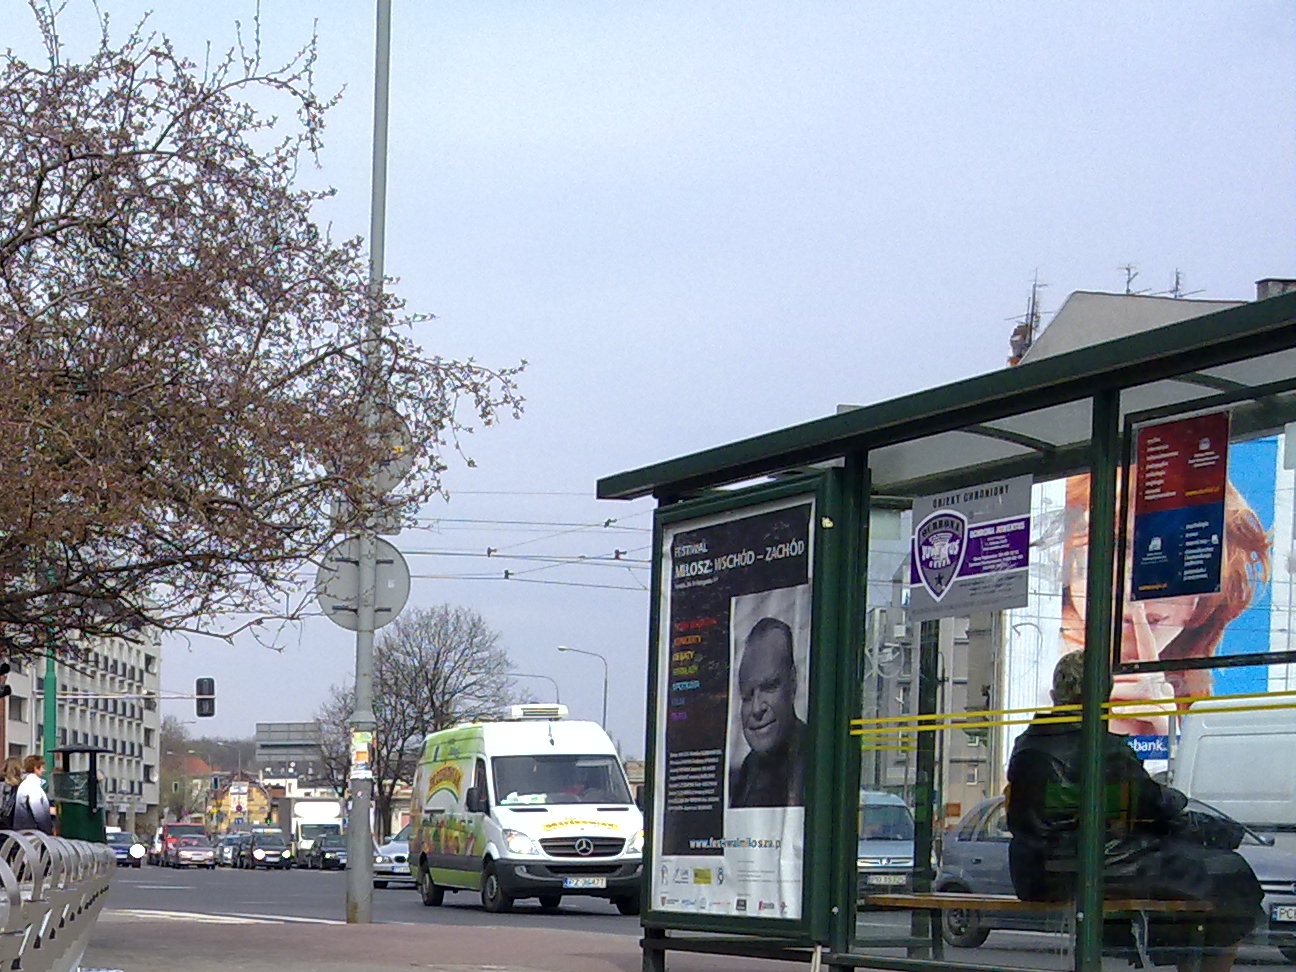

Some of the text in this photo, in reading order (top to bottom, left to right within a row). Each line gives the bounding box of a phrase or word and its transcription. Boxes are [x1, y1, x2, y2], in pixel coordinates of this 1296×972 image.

[714, 548, 755, 571] WSCHÓD
[765, 537, 805, 561] ZACHÓD
[689, 836, 782, 849] www.festiwalmilosza.p
